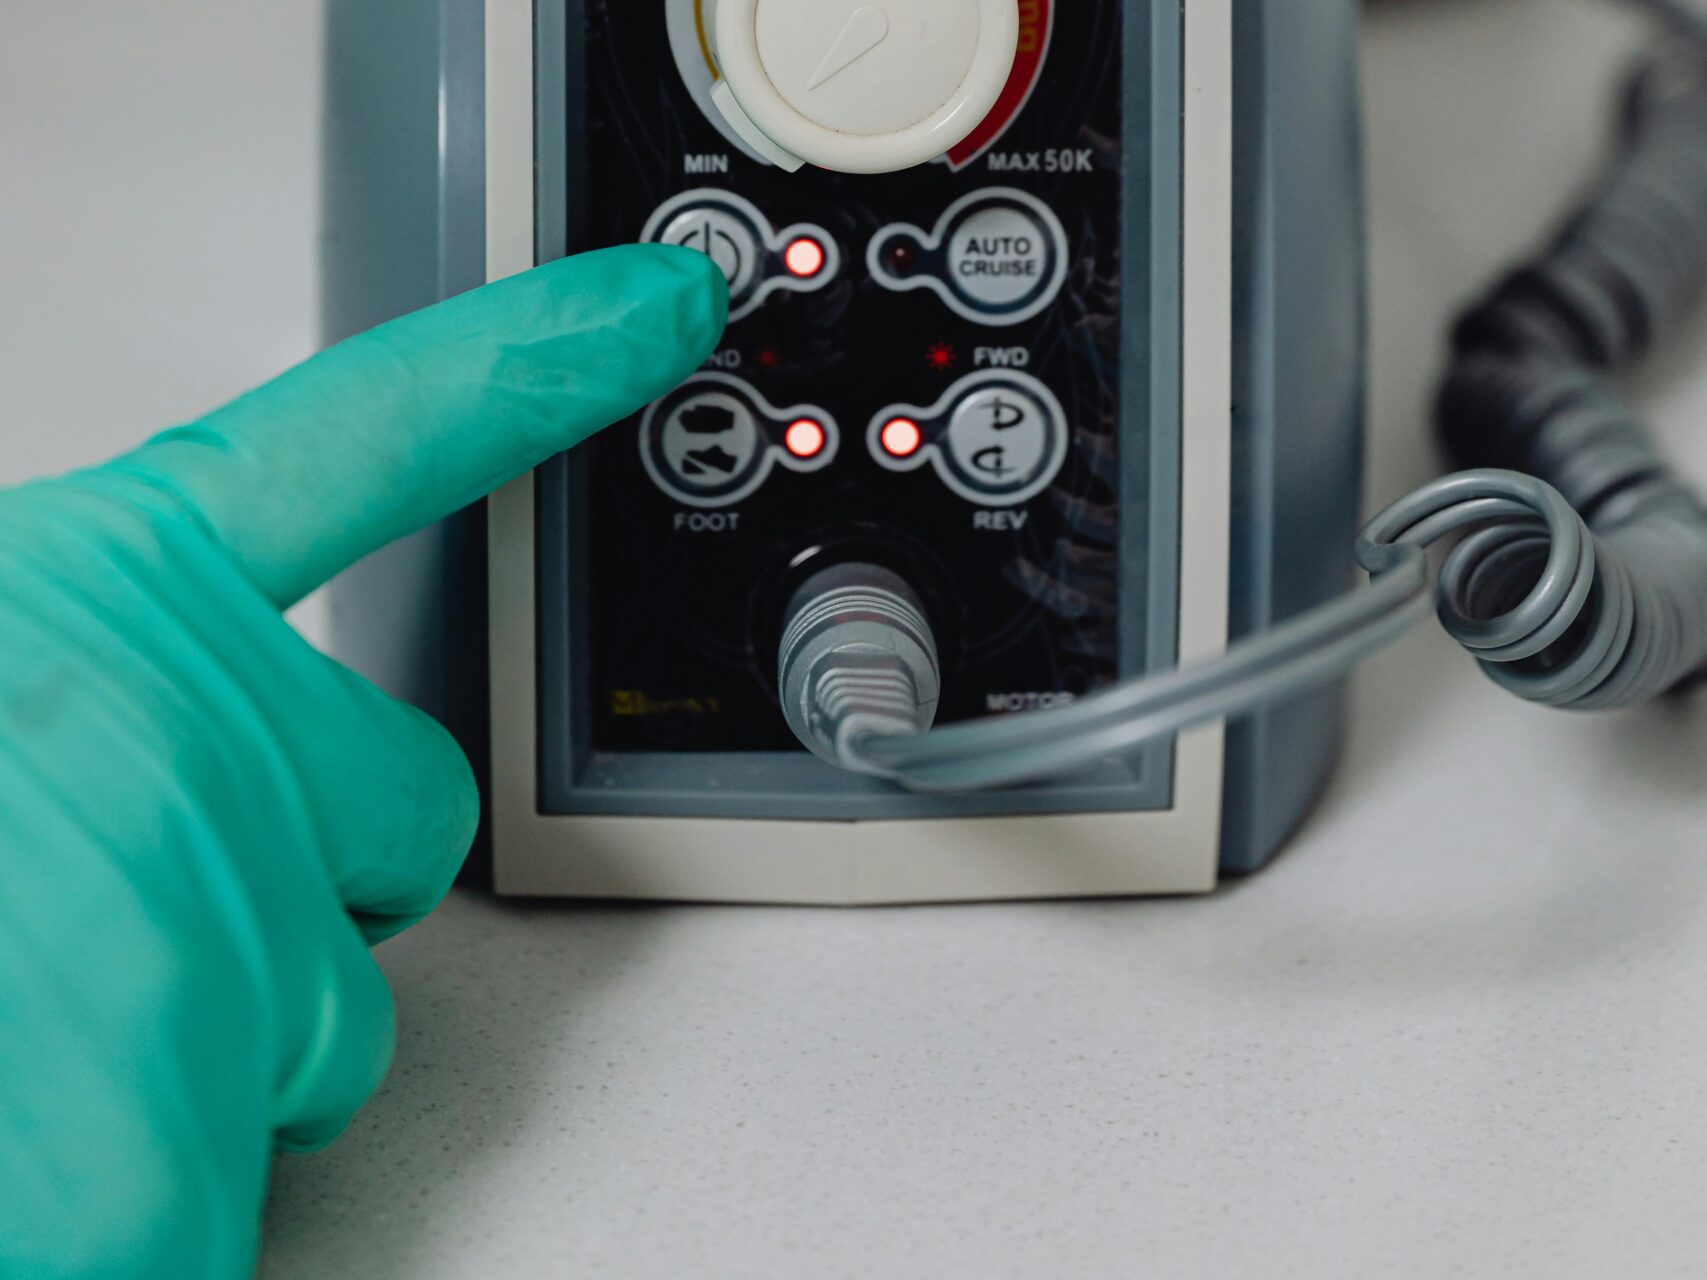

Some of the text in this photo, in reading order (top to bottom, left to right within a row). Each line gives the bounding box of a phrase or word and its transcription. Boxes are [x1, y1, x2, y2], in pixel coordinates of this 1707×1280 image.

[684, 154, 729, 174] MIN
[988, 149, 1093, 172] MAX 50K
[965, 237, 1031, 256] AUTO
[959, 260, 1036, 277] CRUISE
[974, 348, 1030, 367] FWD
[675, 513, 740, 532] FOOT
[973, 511, 1028, 530] REV
